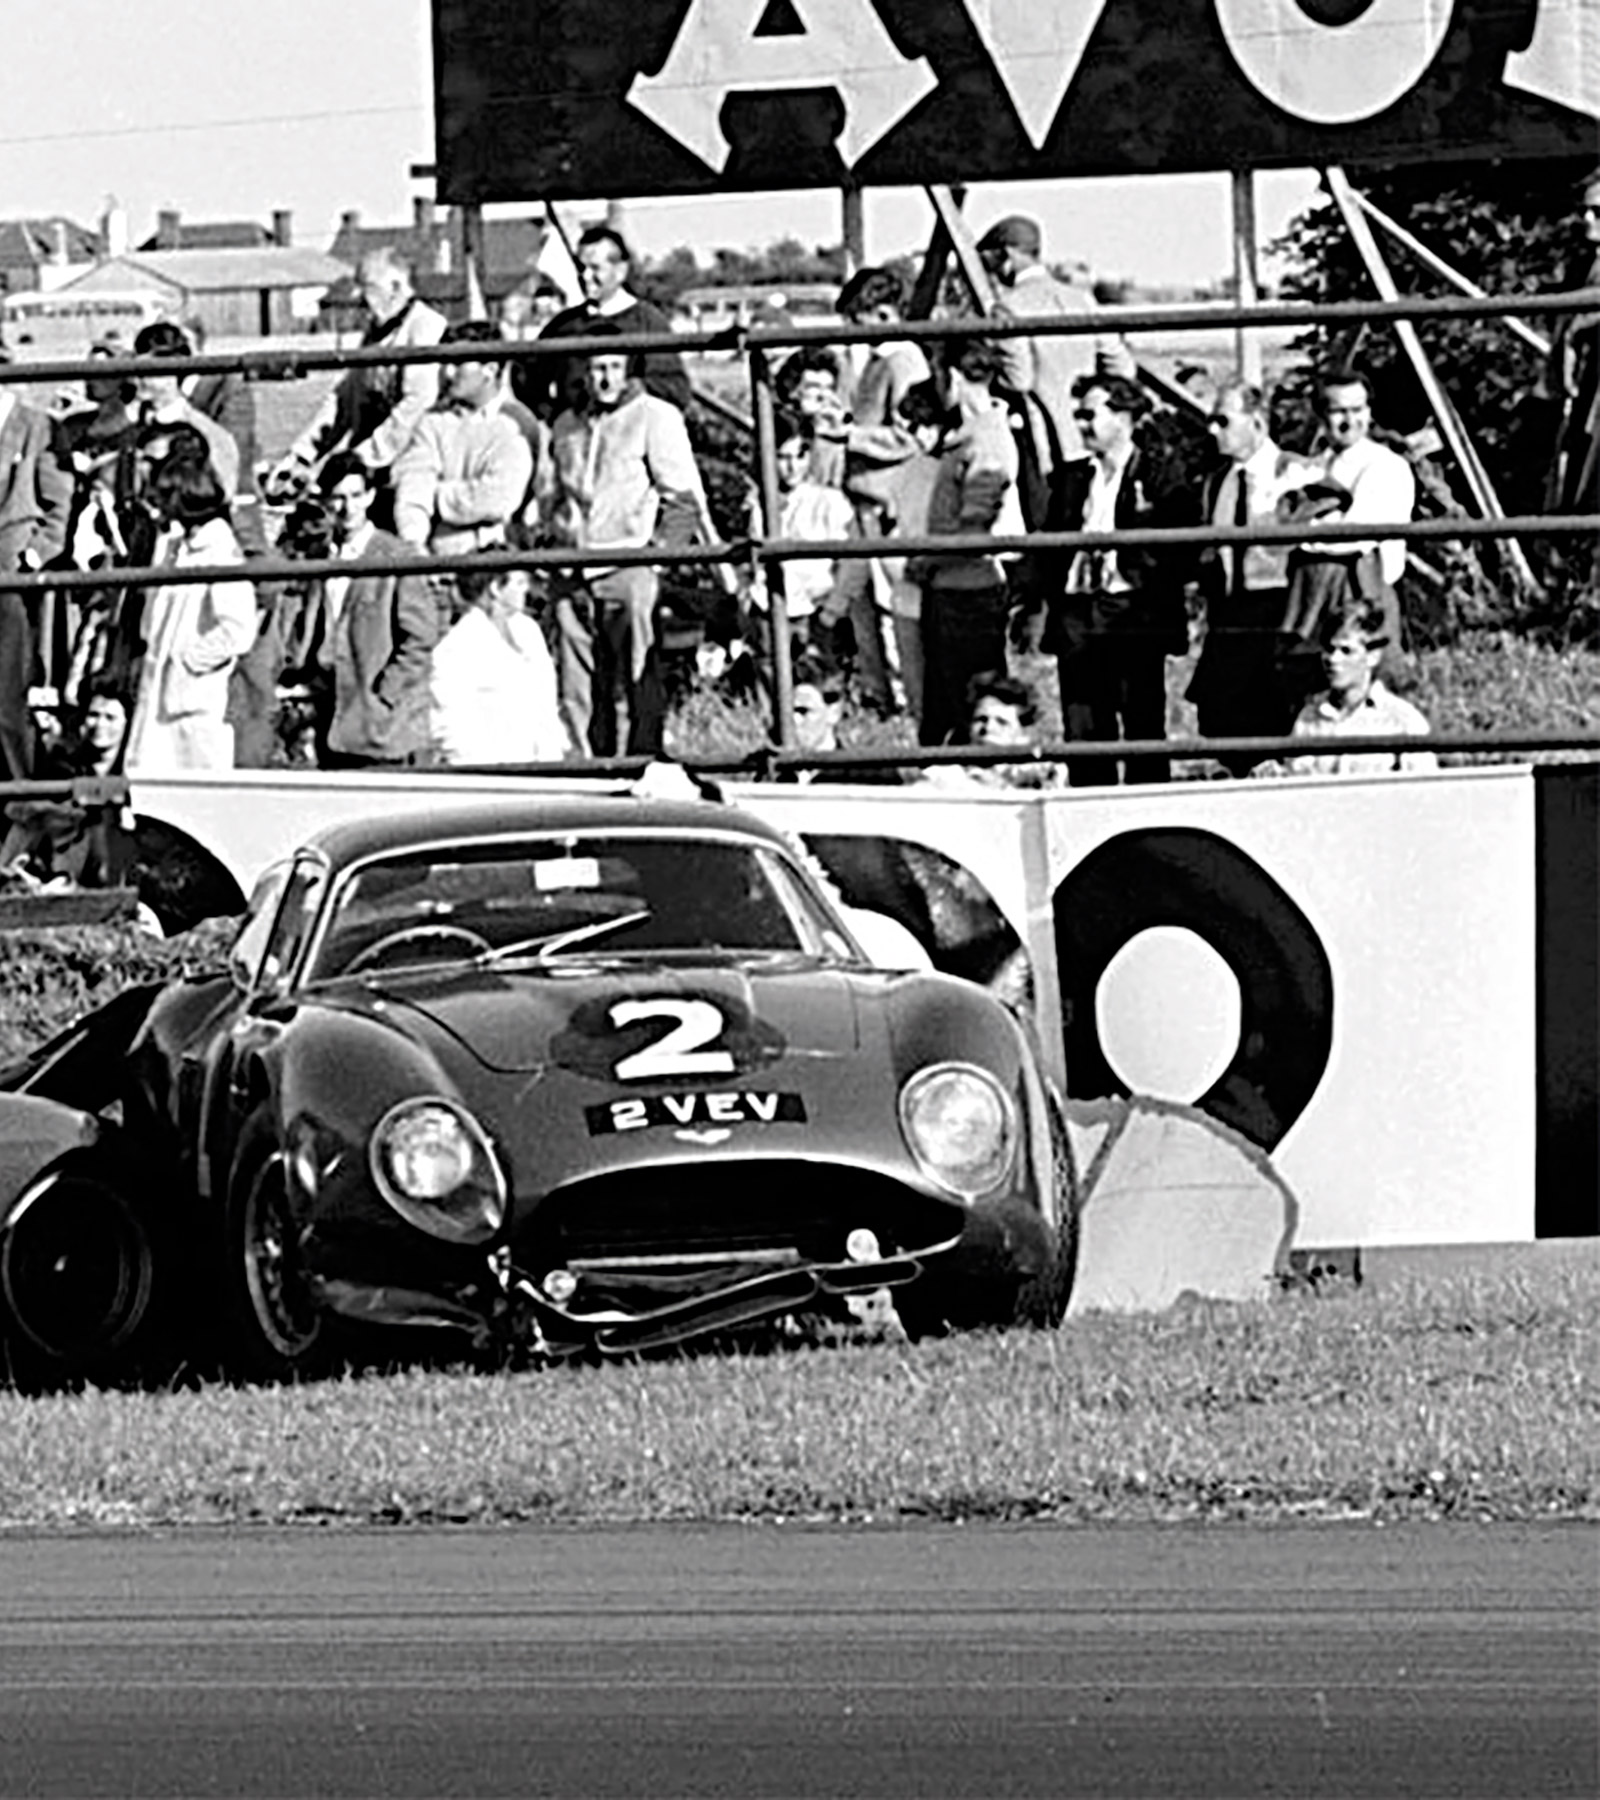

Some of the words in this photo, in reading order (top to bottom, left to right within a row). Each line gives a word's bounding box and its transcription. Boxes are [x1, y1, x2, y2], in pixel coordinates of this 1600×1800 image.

[608, 999, 736, 1081] 2
[609, 1099, 650, 1132] 2
[662, 1092, 779, 1124] VEV
